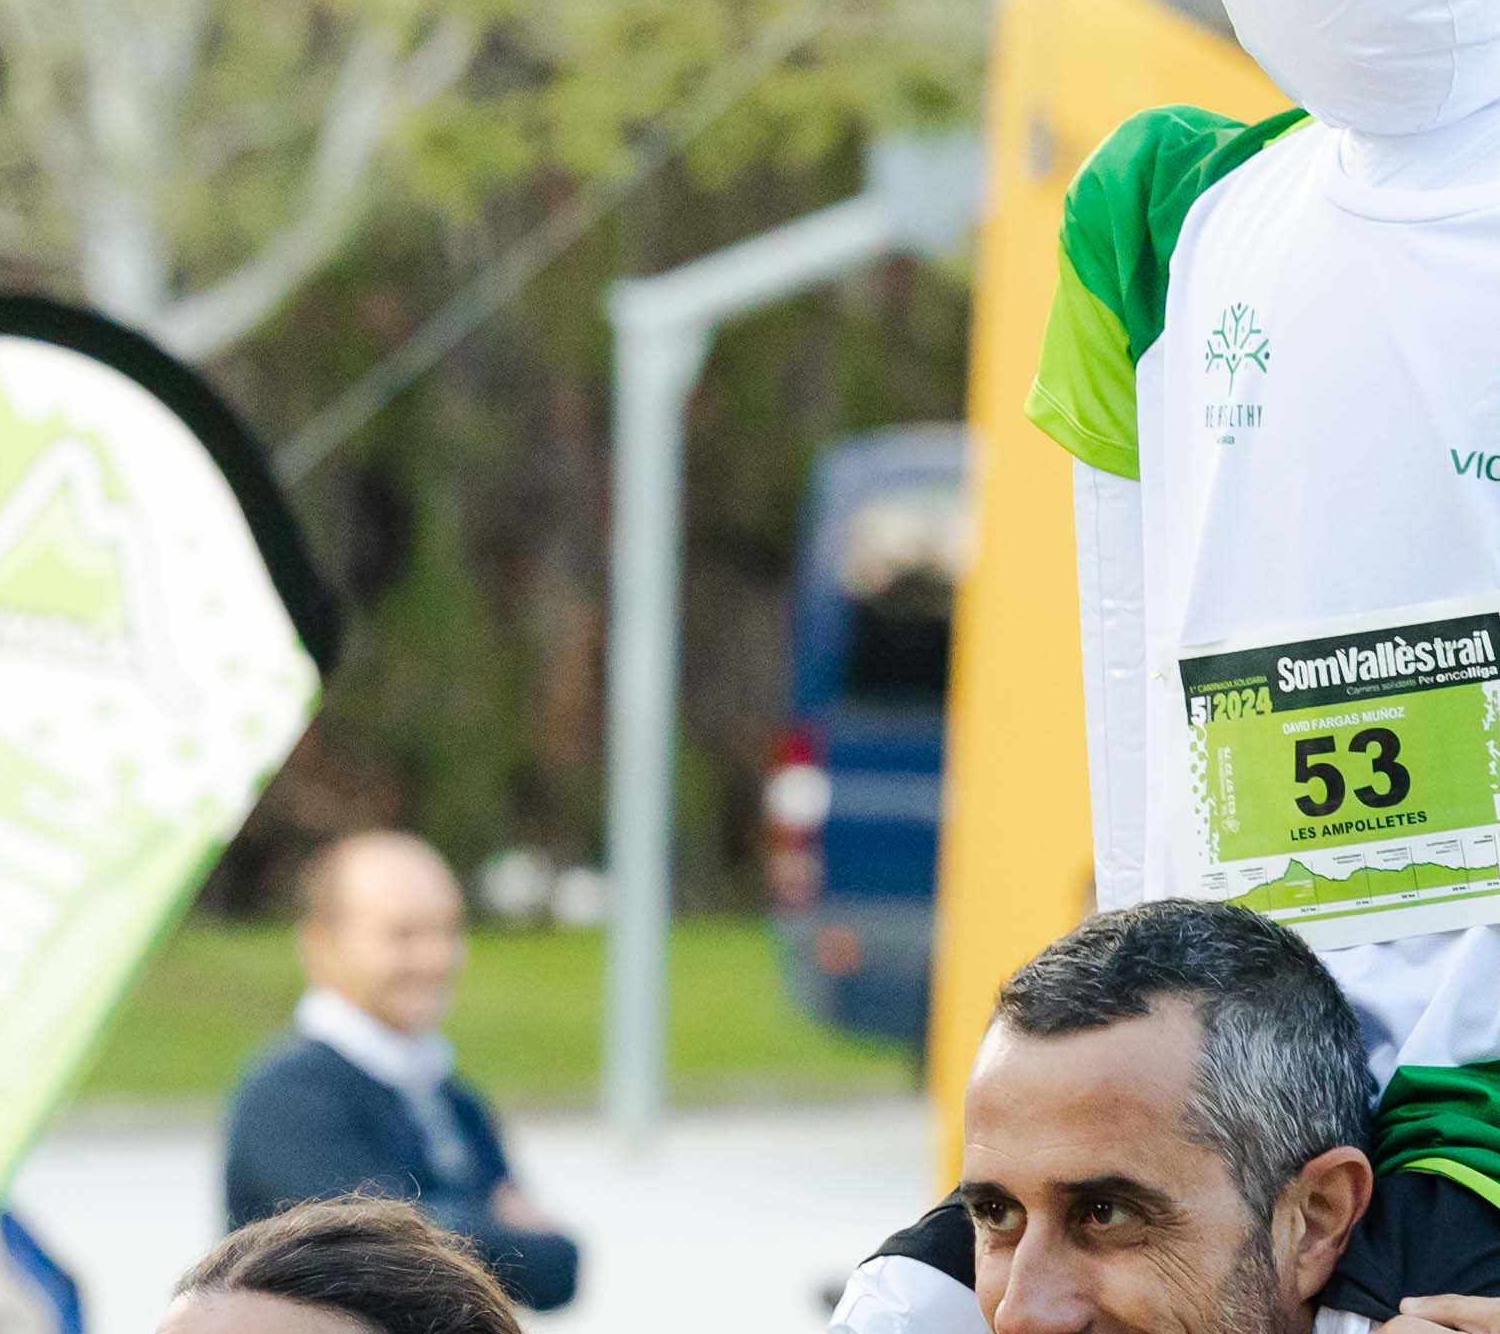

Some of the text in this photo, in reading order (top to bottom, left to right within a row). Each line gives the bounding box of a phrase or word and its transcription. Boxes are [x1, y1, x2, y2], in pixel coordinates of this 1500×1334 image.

[1277, 629, 1497, 693] SomVallèstrail
[1436, 665, 1499, 684] oncolliga
[1212, 686, 1273, 723] 2024
[1283, 705, 1407, 735] DAVID FARGAS MUÑOZ
[1294, 727, 1411, 818] 53
[1290, 810, 1428, 841] LES AMPOLLETES
